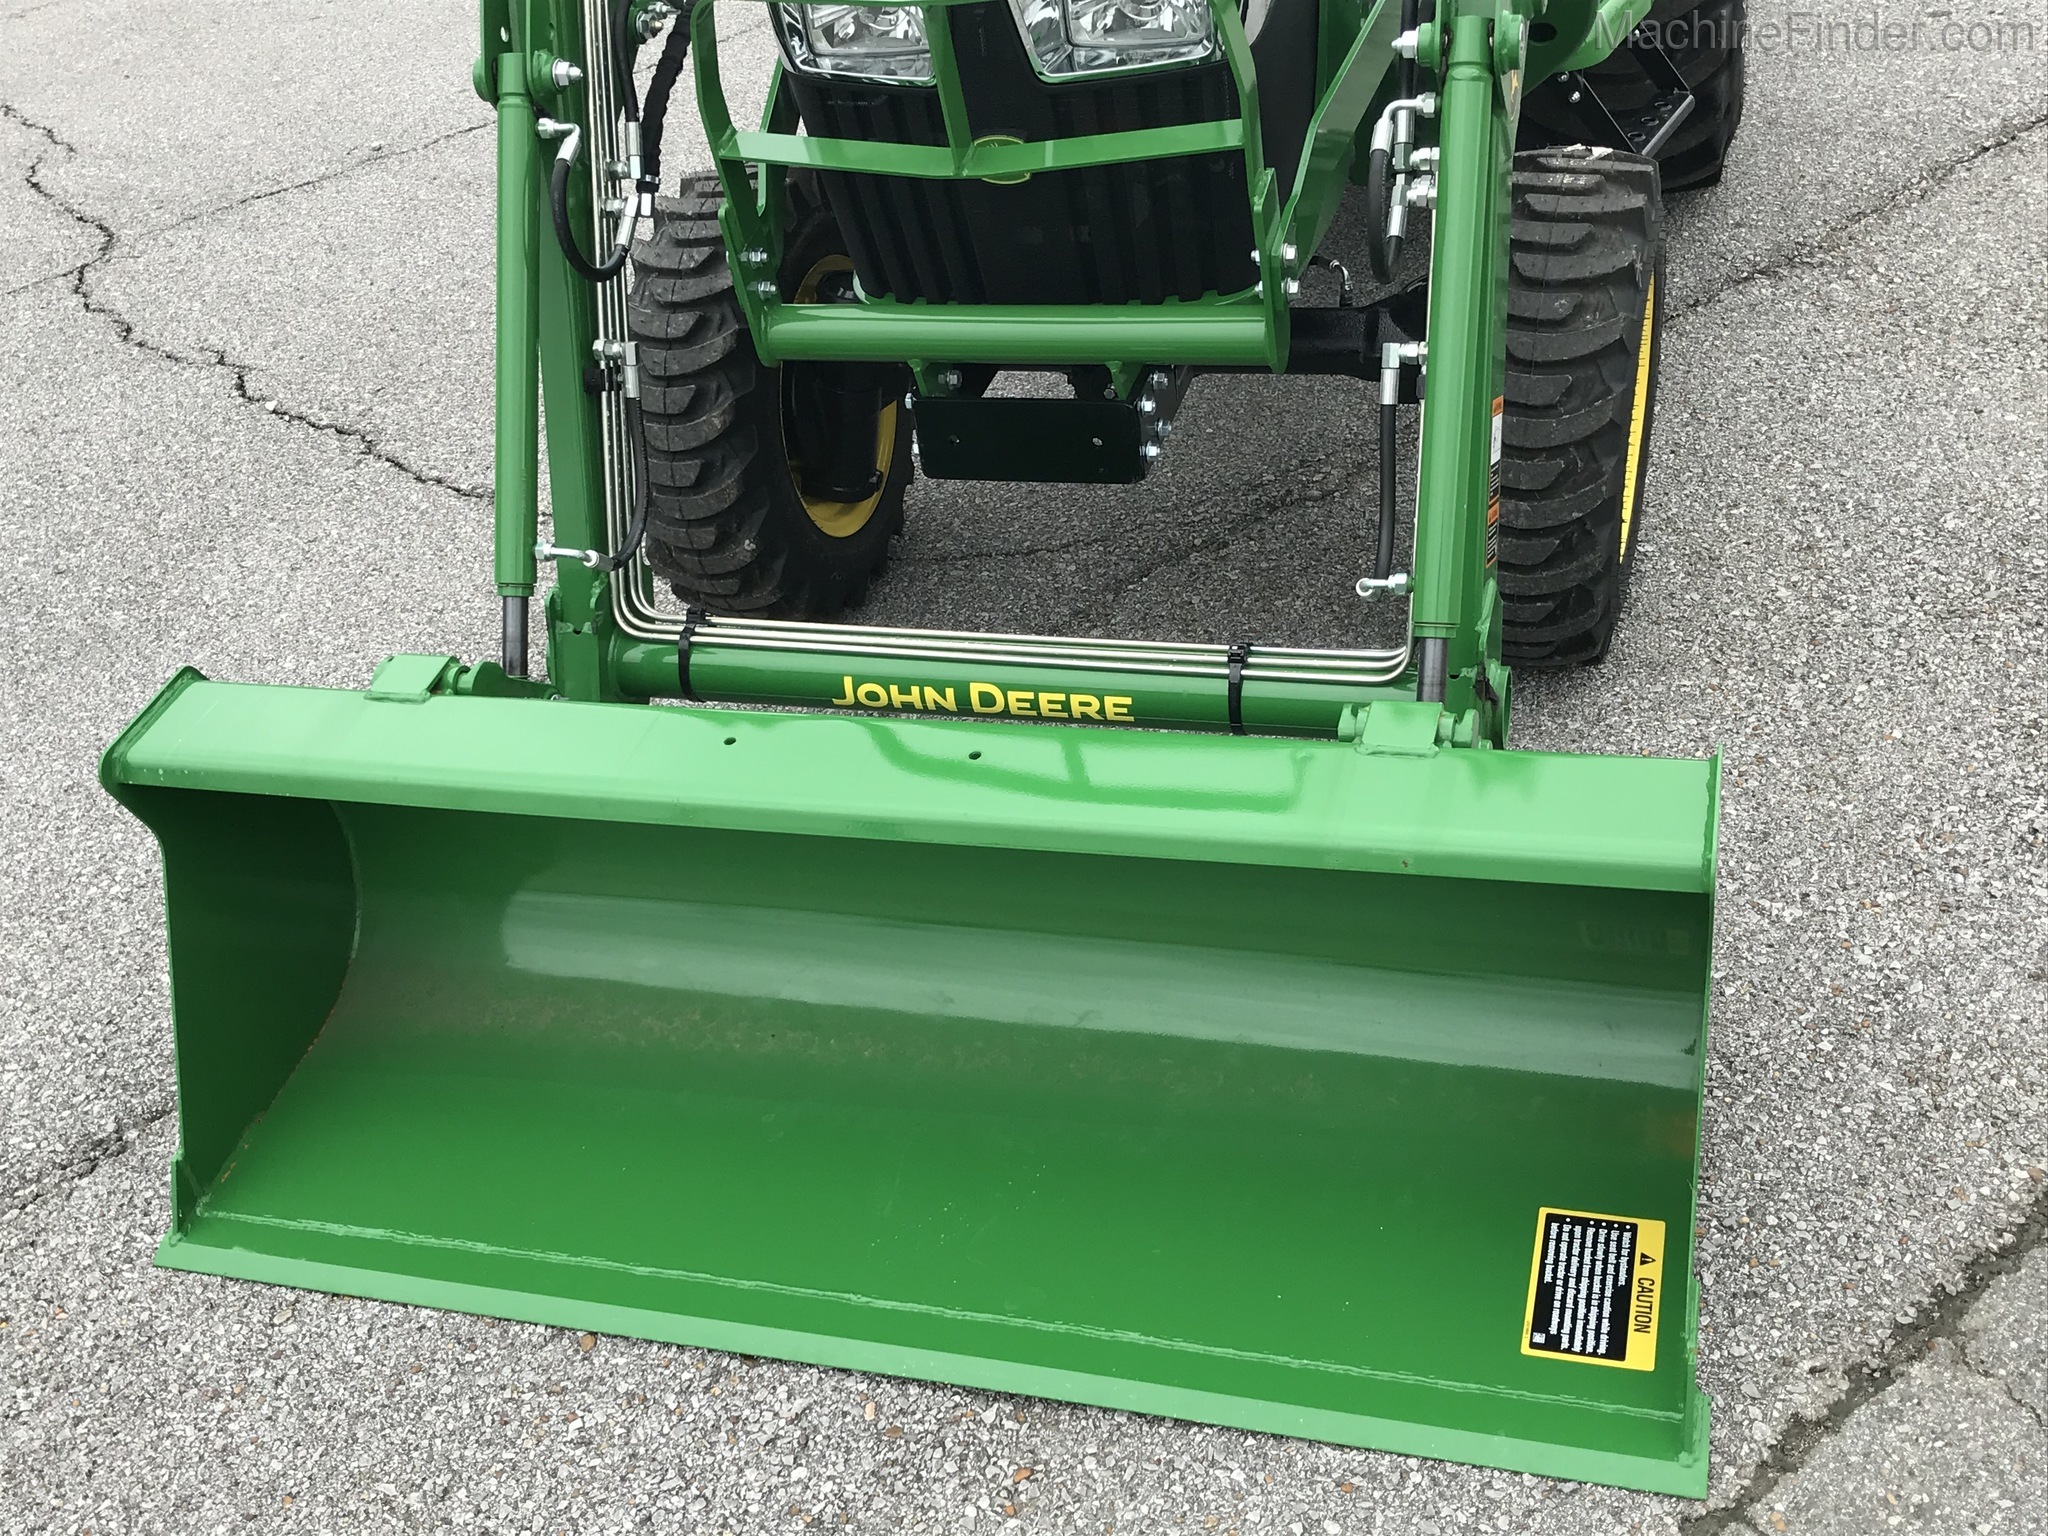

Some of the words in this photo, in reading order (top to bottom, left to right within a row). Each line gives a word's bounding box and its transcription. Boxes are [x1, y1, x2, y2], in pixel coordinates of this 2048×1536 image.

[832, 676, 958, 712] JOHN
[969, 682, 1135, 722] DEERE
[1550, 1223, 1559, 1239] before
[1573, 1226, 1581, 1238] upon
[1585, 1227, 1595, 1247] Remove
[1598, 1229, 1607, 1242] Drive
[1610, 1230, 1619, 1240] Use
[1622, 1232, 1631, 1248] Watch
[1545, 1240, 1556, 1264] removing
[1559, 1242, 1568, 1261] operate
[1572, 1239, 1581, 1256] tractor
[1595, 1243, 1605, 1260] slowly
[1609, 1241, 1617, 1252] seat
[1583, 1248, 1593, 1264] bucket
[1609, 1253, 1617, 1263] belt
[1544, 1265, 1554, 1283] bucket.
[1557, 1262, 1566, 1279] tractor
[1568, 1256, 1579, 1277] delivery
[1595, 1261, 1603, 1275] when
[1607, 1264, 1615, 1274] and
[1618, 1257, 1629, 1286] bystanders.
[1554, 1286, 1563, 1300] drive
[1578, 1277, 1589, 1298] shipping
[1593, 1276, 1602, 1293] bucket
[1604, 1275, 1614, 1297] exercise
[1566, 1288, 1576, 1308] discard
[1634, 1278, 1655, 1334] CAUTION
[1577, 1299, 1586, 1319] position
[1602, 1298, 1611, 1317] caution
[1549, 1309, 1560, 1335] roadways
[1561, 1309, 1572, 1333] mounting
[1587, 1306, 1599, 1329] shipping
[1601, 1319, 1609, 1333] while
[1560, 1334, 1569, 1350] parts.
[1571, 1320, 1585, 1352] immediately
[1586, 1330, 1596, 1354] position.
[1597, 1334, 1608, 1355] driving.
